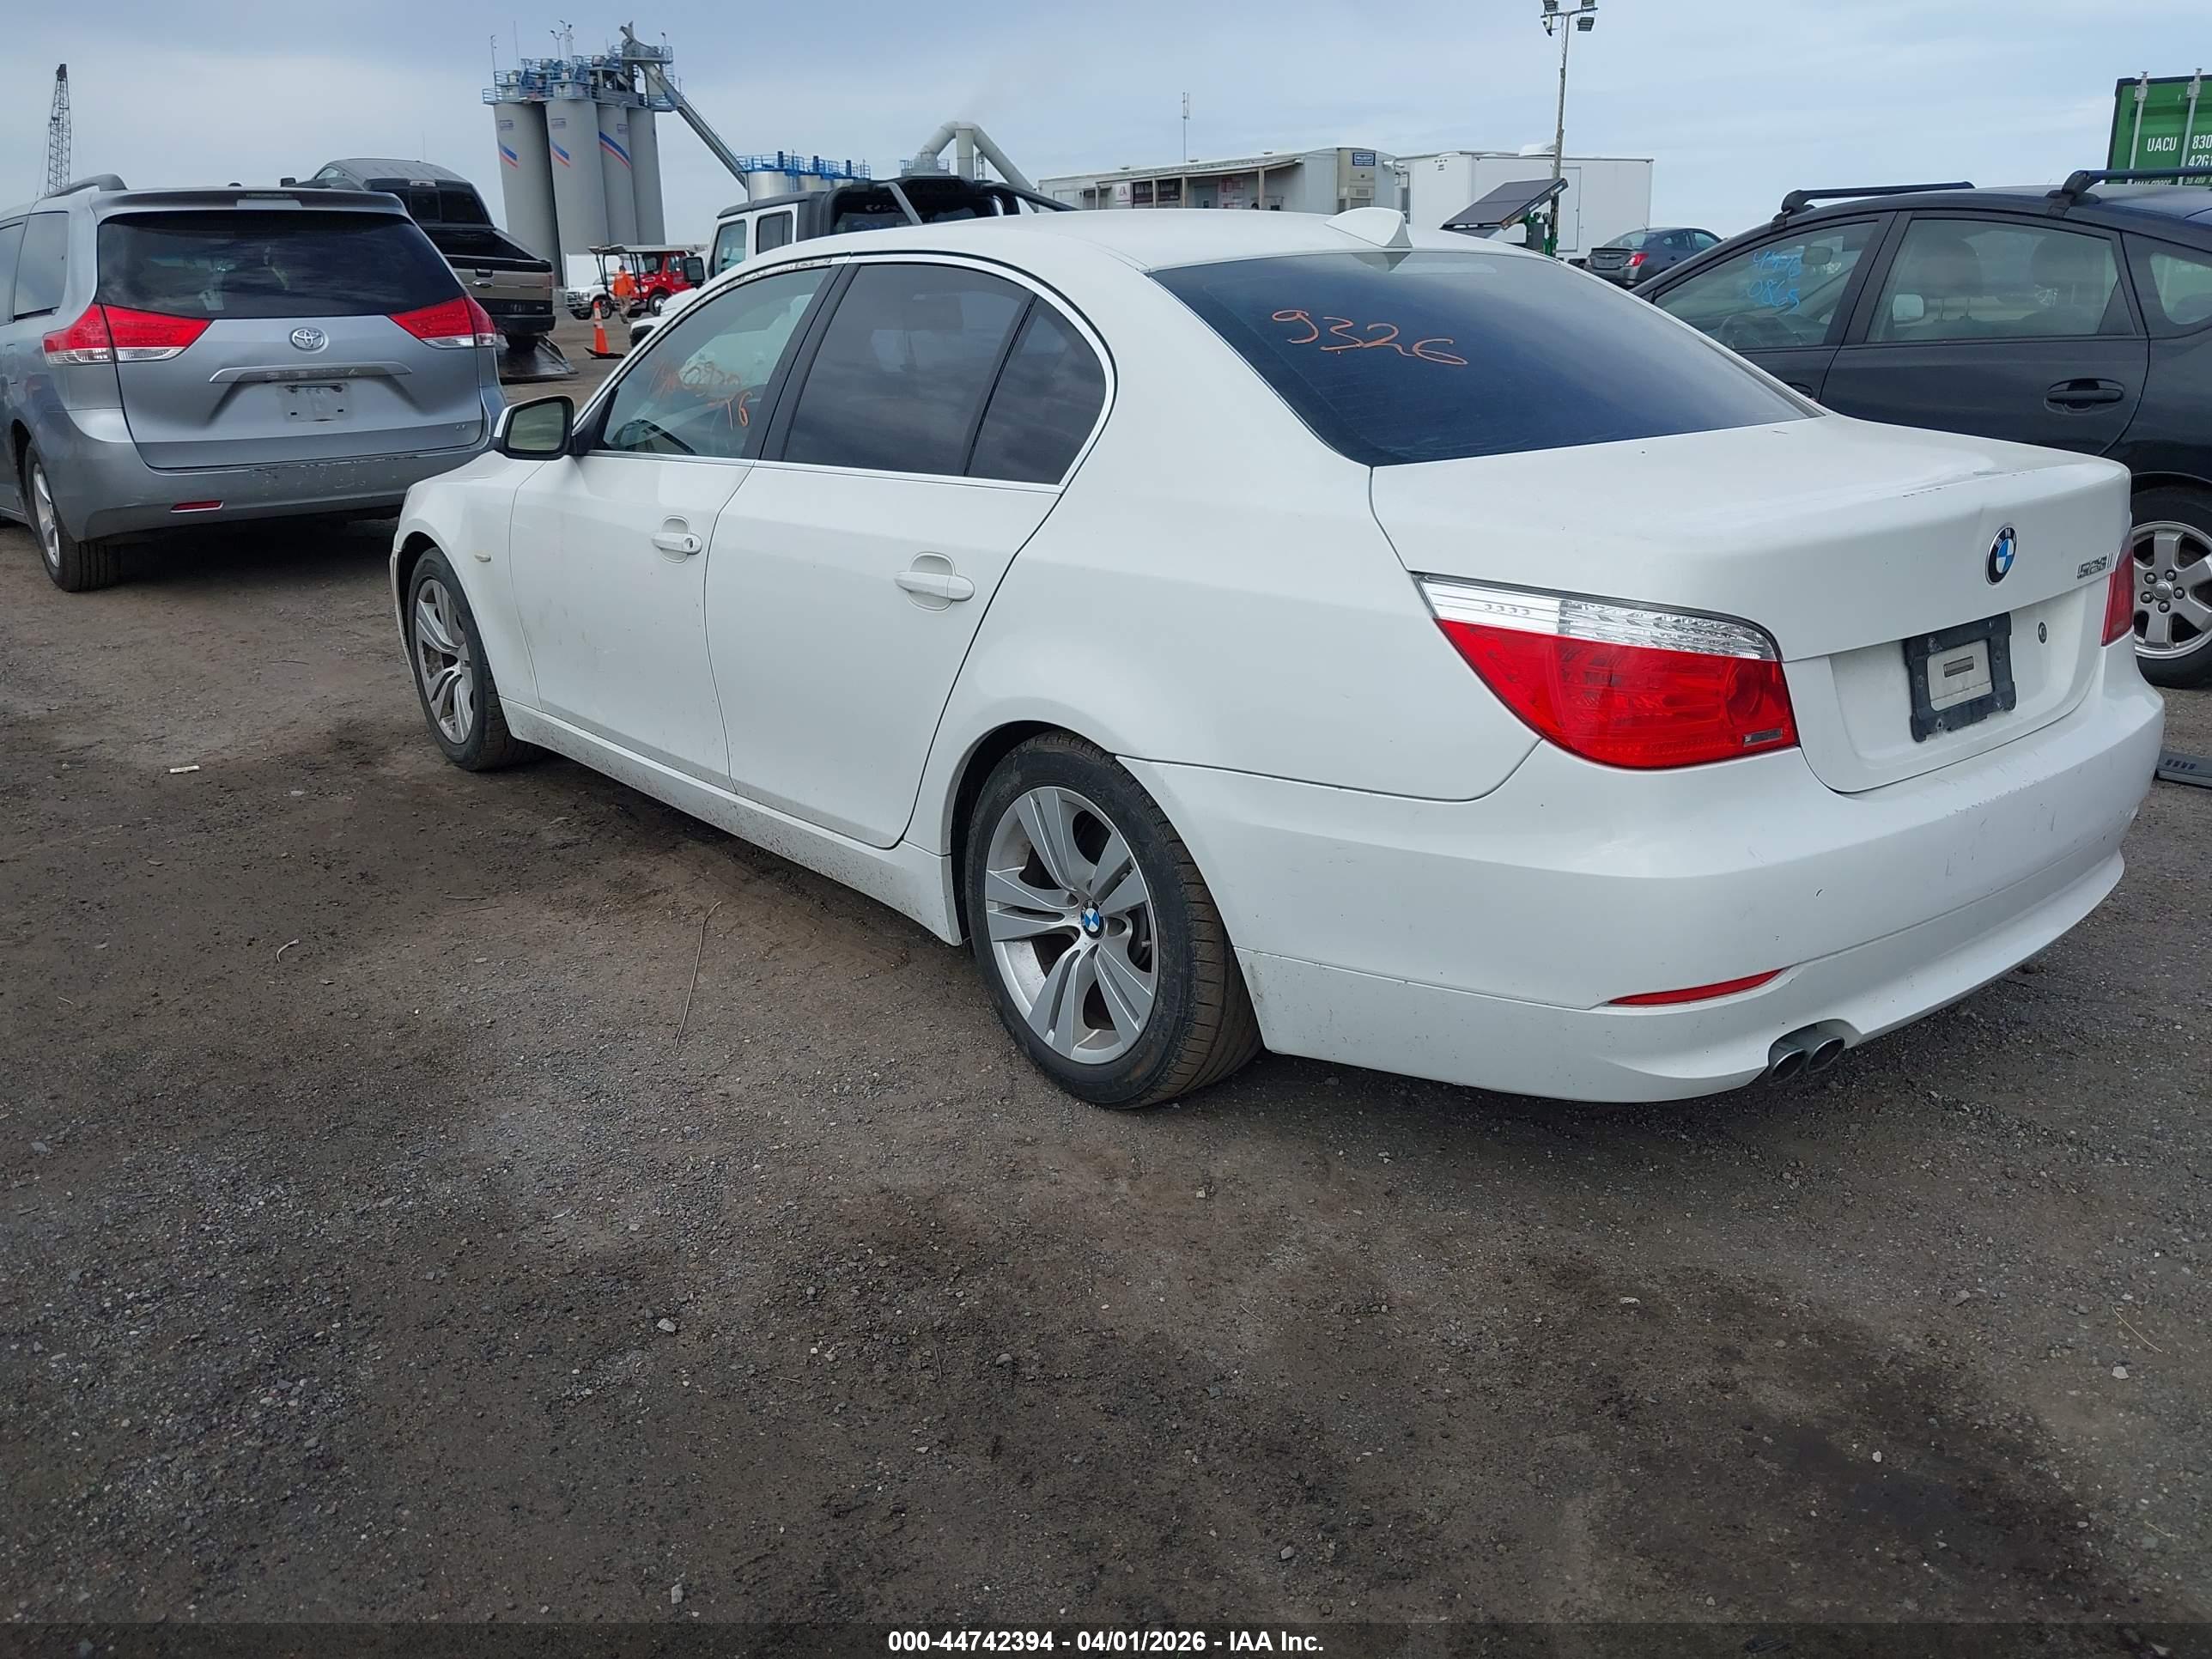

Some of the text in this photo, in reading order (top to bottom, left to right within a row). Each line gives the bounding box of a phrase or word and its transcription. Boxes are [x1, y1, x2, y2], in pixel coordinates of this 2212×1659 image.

[2147, 134, 2212, 152] UACU 830
[1272, 309, 1469, 366] 9326
